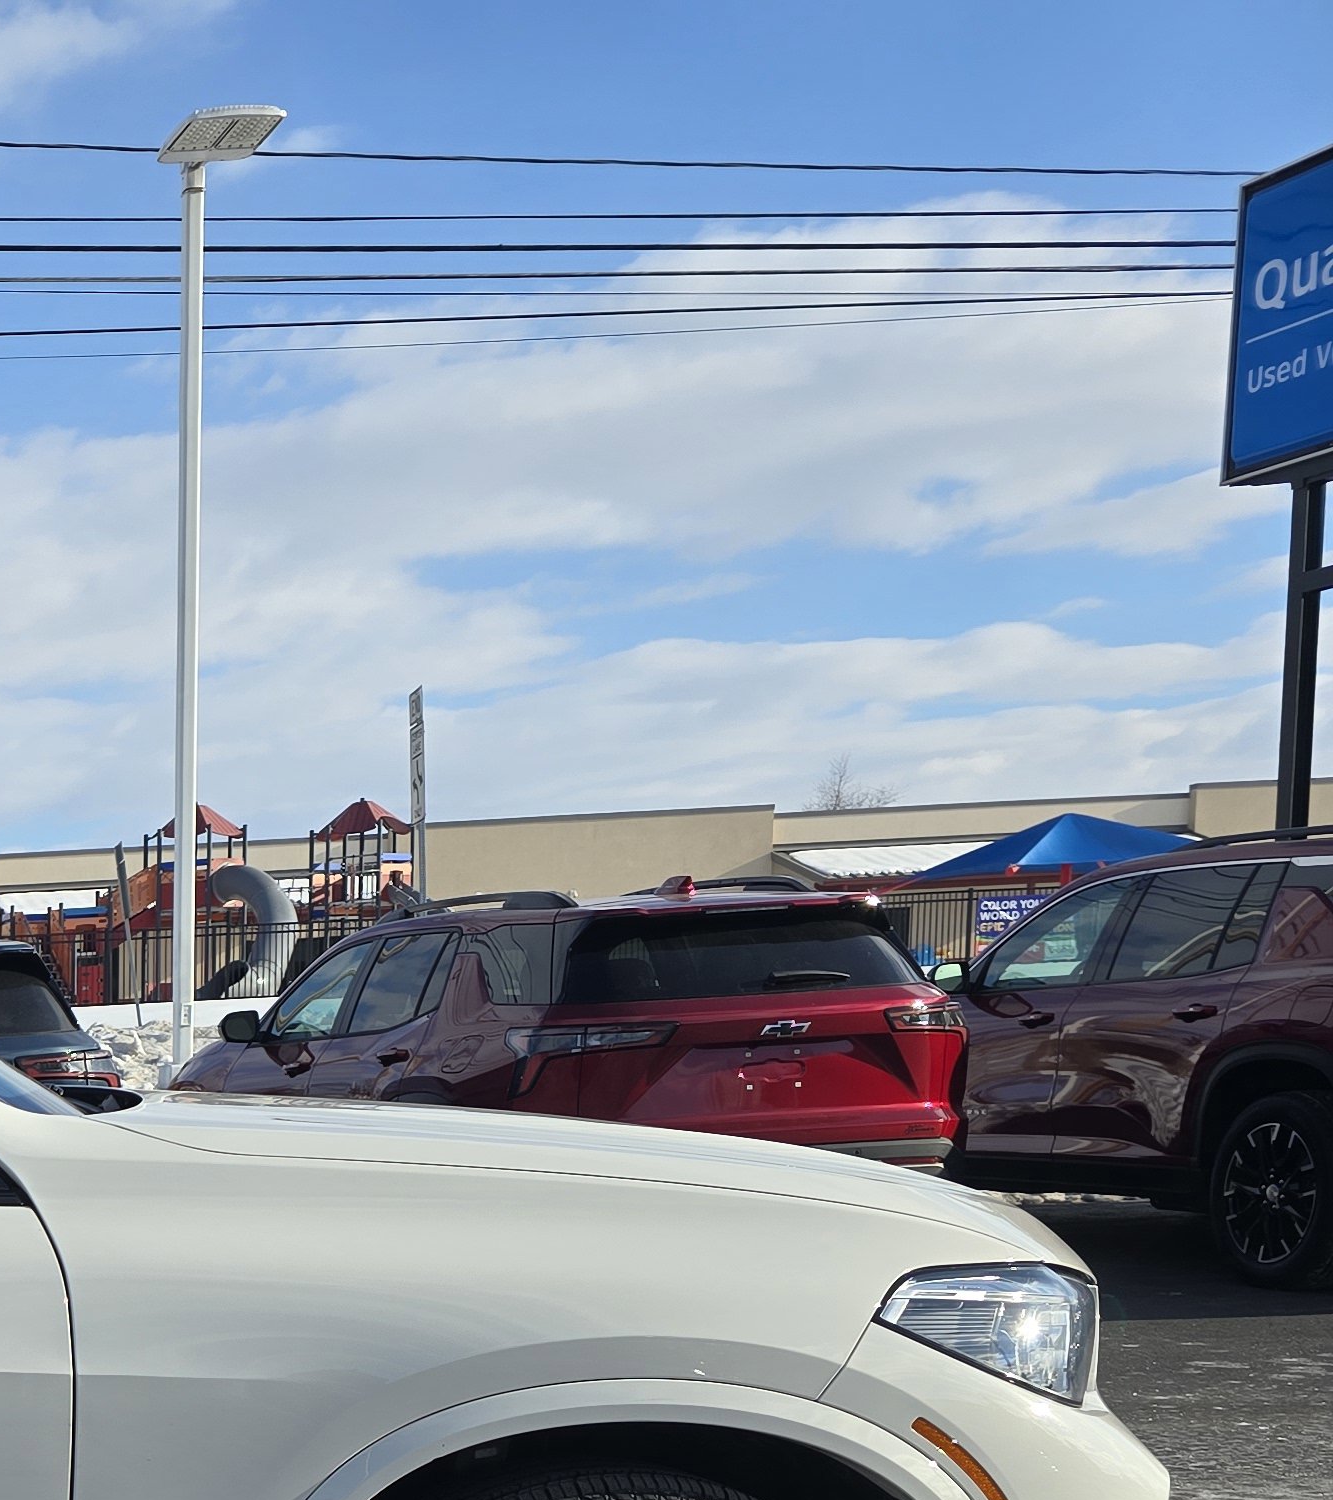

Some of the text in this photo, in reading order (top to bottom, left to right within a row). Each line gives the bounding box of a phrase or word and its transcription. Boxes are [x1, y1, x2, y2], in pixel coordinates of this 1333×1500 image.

[1248, 349, 1307, 393] Used
[981, 900, 1017, 910] COLOR
[980, 911, 1020, 920] WORLD
[980, 922, 1004, 932] EPIC
